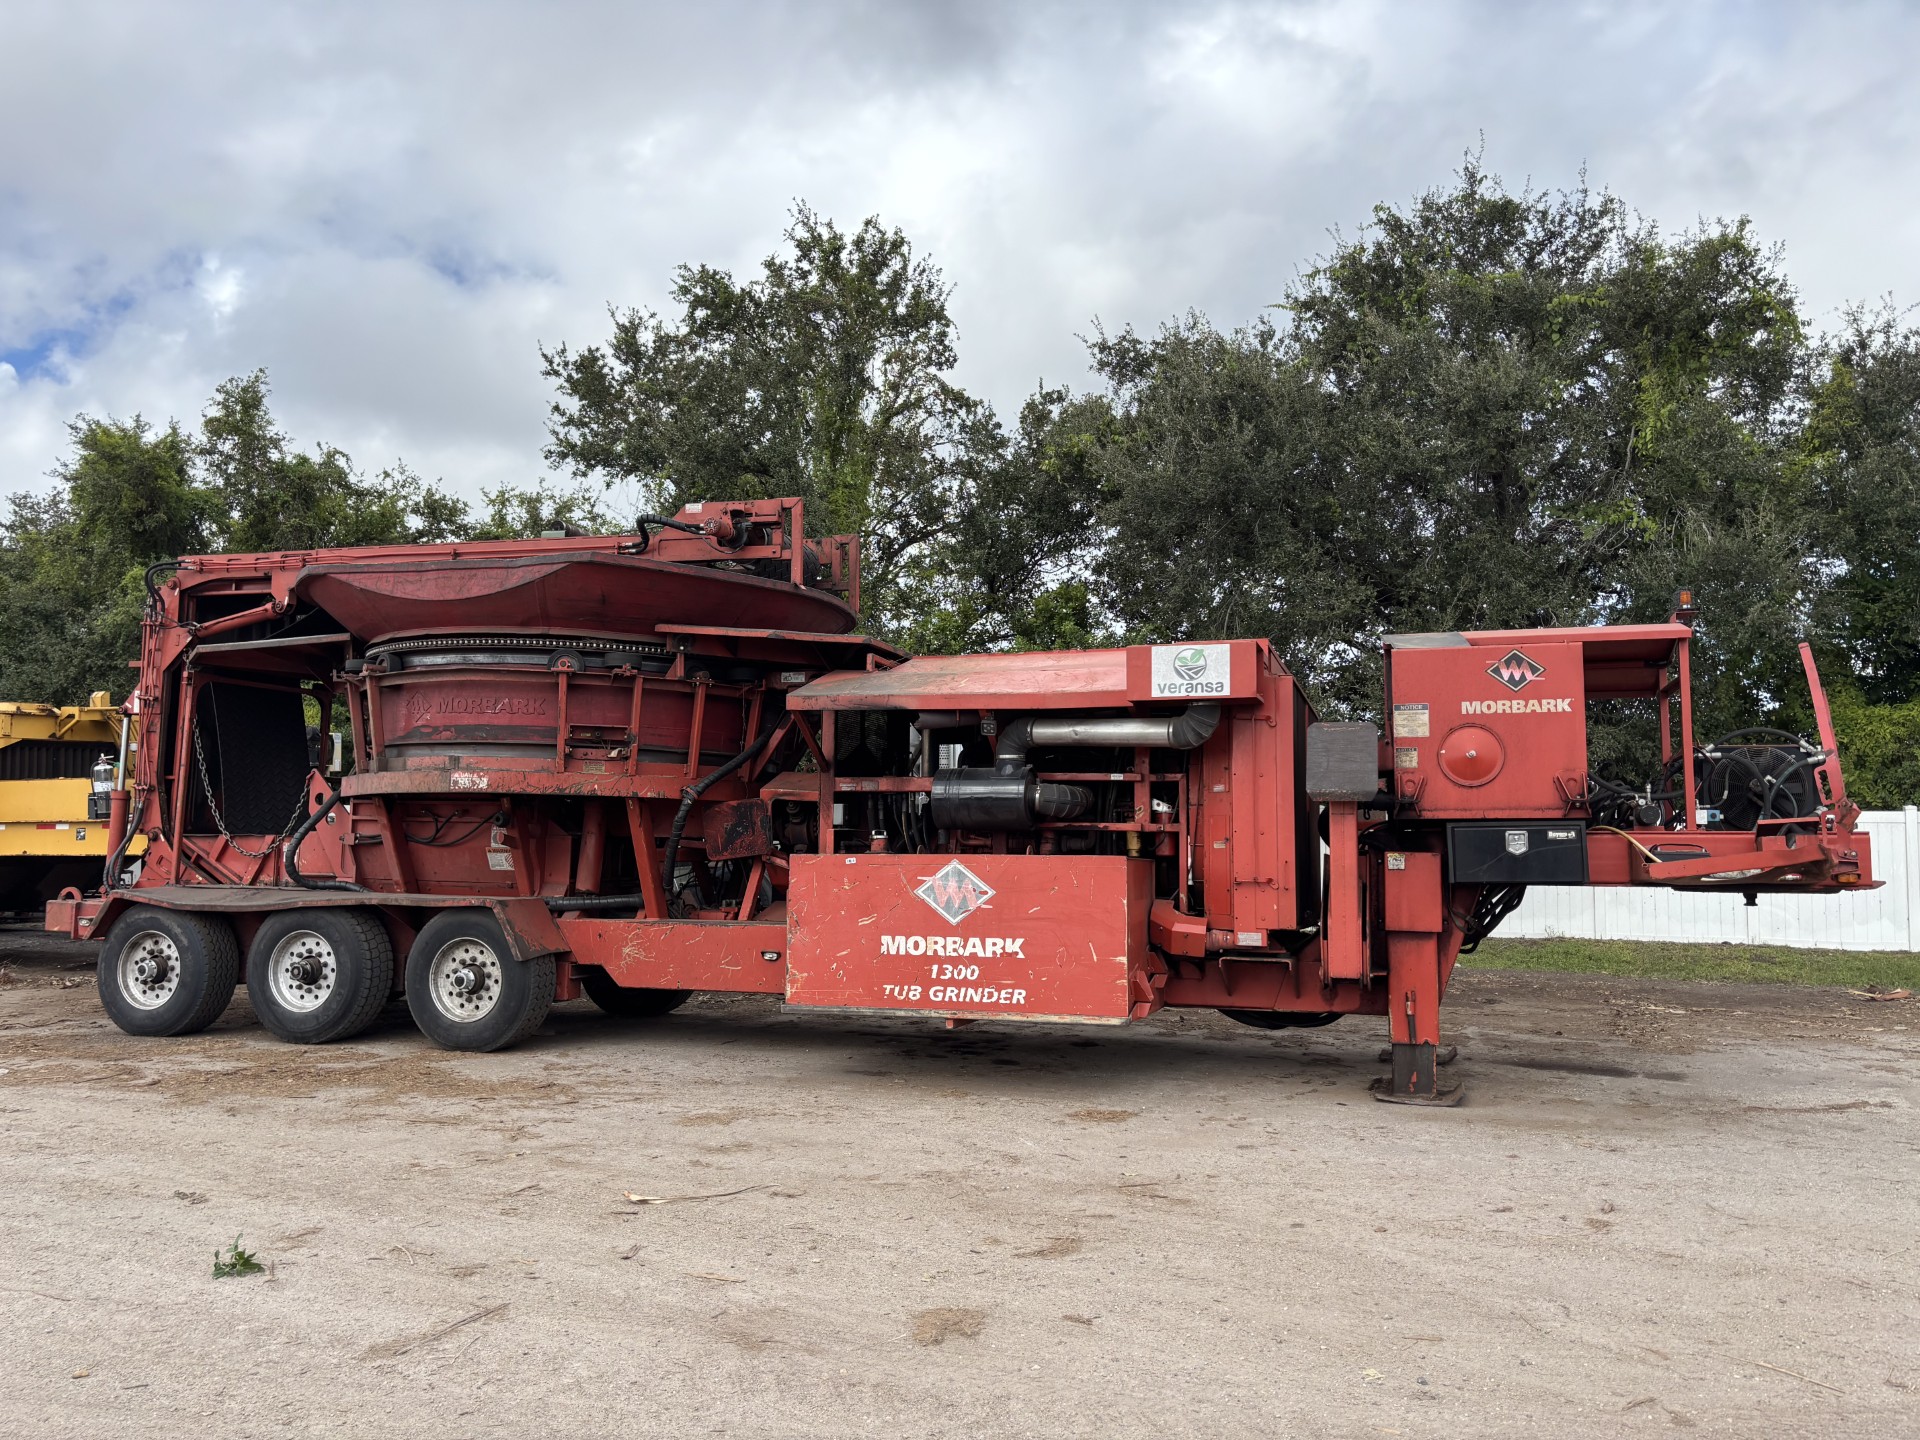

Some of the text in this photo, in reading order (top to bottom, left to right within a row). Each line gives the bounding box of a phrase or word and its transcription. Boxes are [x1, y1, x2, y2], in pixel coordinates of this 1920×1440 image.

[1157, 681, 1224, 694] veransa
[436, 698, 547, 716] MORBARK
[1461, 698, 1572, 715] MORBARK
[880, 935, 1025, 959] MORBARK
[930, 964, 980, 981] 1300
[882, 984, 1027, 1005] TUB GRINDER
